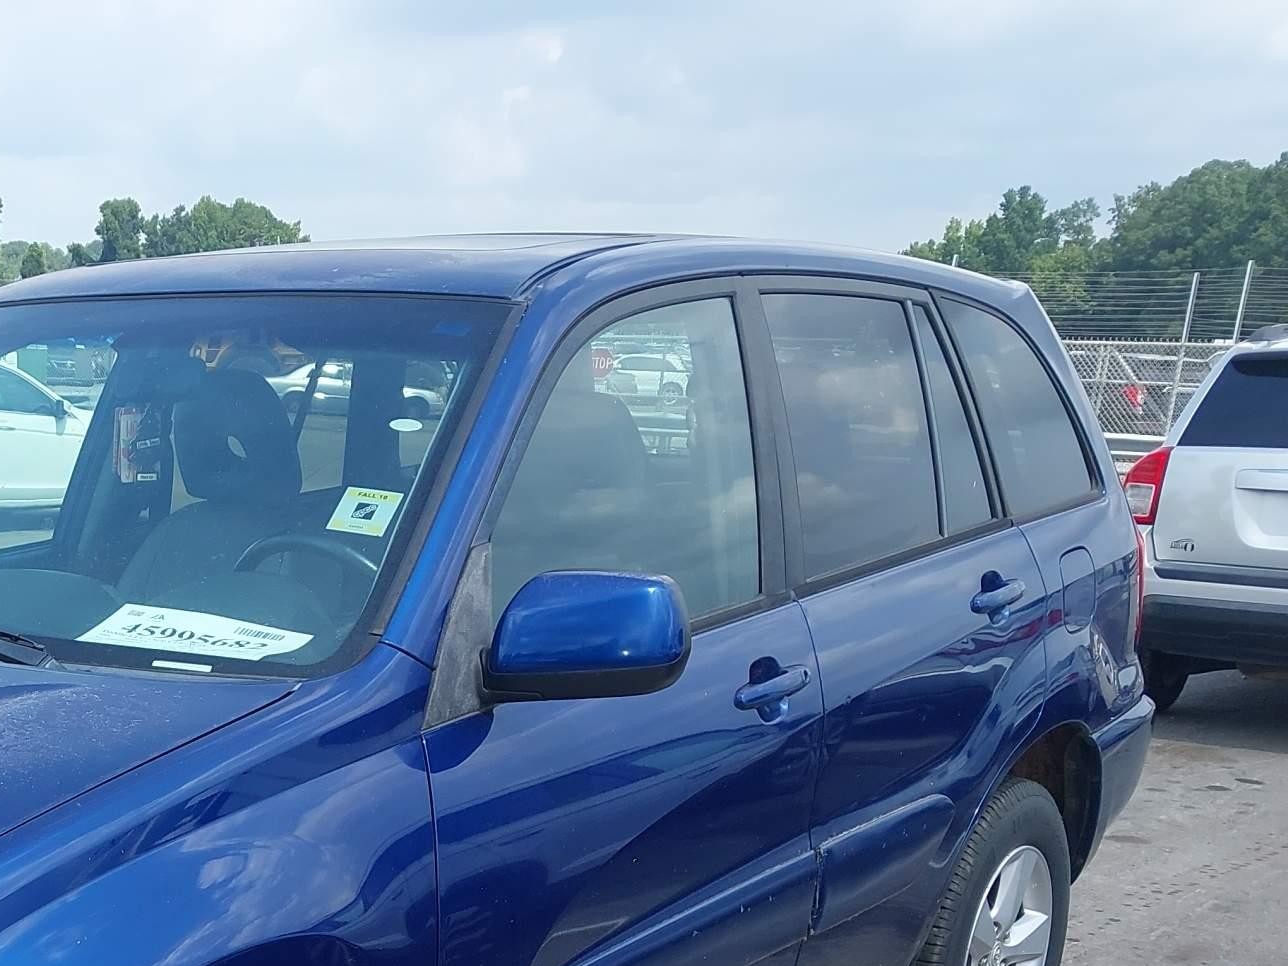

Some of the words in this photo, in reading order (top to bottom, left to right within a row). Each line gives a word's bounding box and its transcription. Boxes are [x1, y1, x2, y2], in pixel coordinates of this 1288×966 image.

[592, 356, 613, 369] TOP
[358, 491, 377, 499] FALL
[120, 623, 269, 650] 45995682
